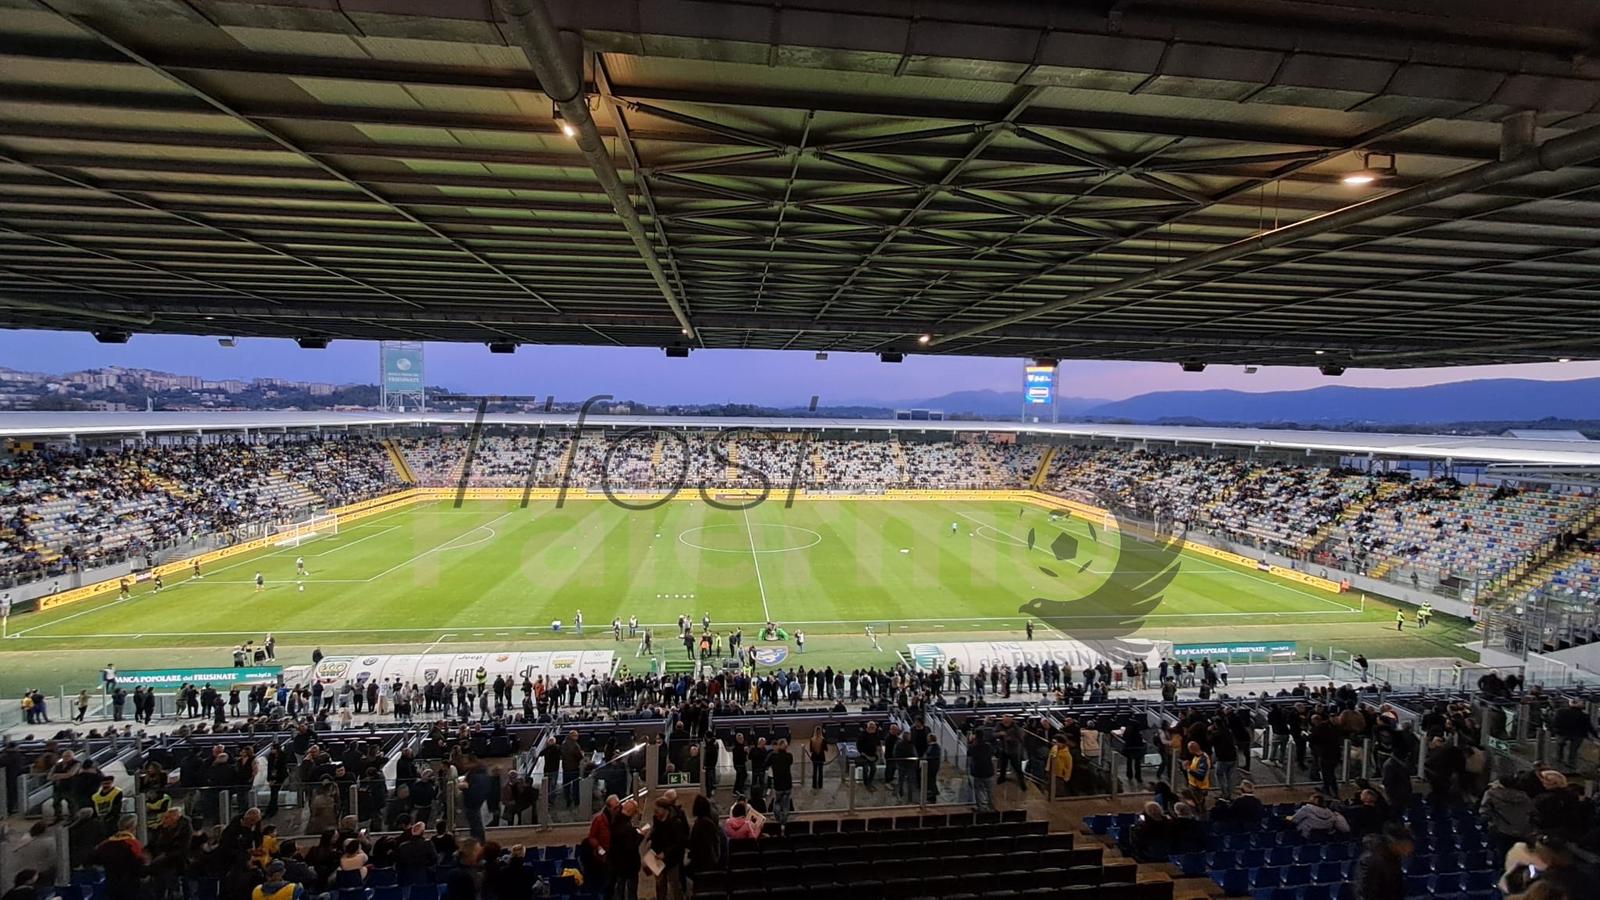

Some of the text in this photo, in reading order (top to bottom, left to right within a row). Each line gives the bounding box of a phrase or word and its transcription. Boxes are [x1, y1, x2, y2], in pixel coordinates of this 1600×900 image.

[140, 674, 182, 683] POPOLARE
[194, 672, 236, 681] FRUSINATE
[454, 668, 475, 683] FIAT
